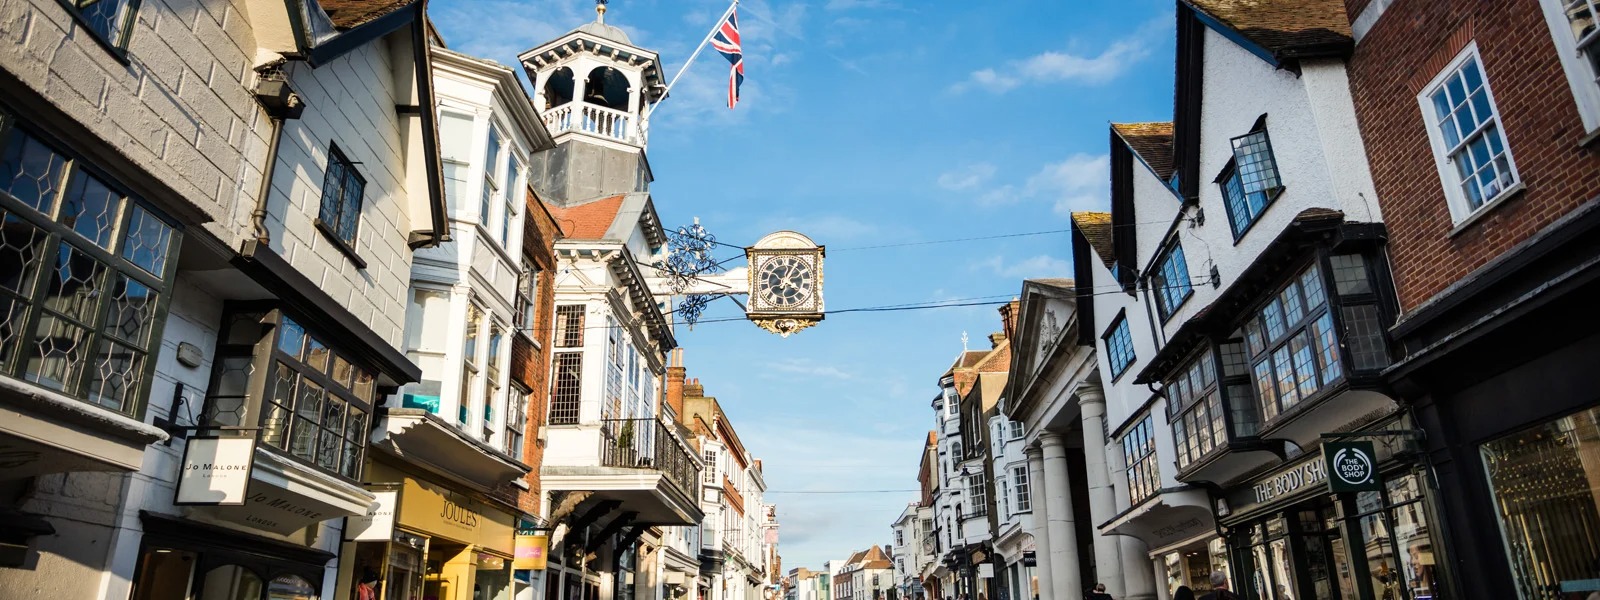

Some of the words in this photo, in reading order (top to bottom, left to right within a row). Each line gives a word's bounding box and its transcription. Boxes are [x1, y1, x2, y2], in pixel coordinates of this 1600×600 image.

[1252, 480, 1275, 503] THE
[1275, 466, 1305, 496] BODY
[1305, 457, 1327, 484] SHO
[266, 498, 322, 519] MALONE
[440, 500, 478, 528] JOULES
